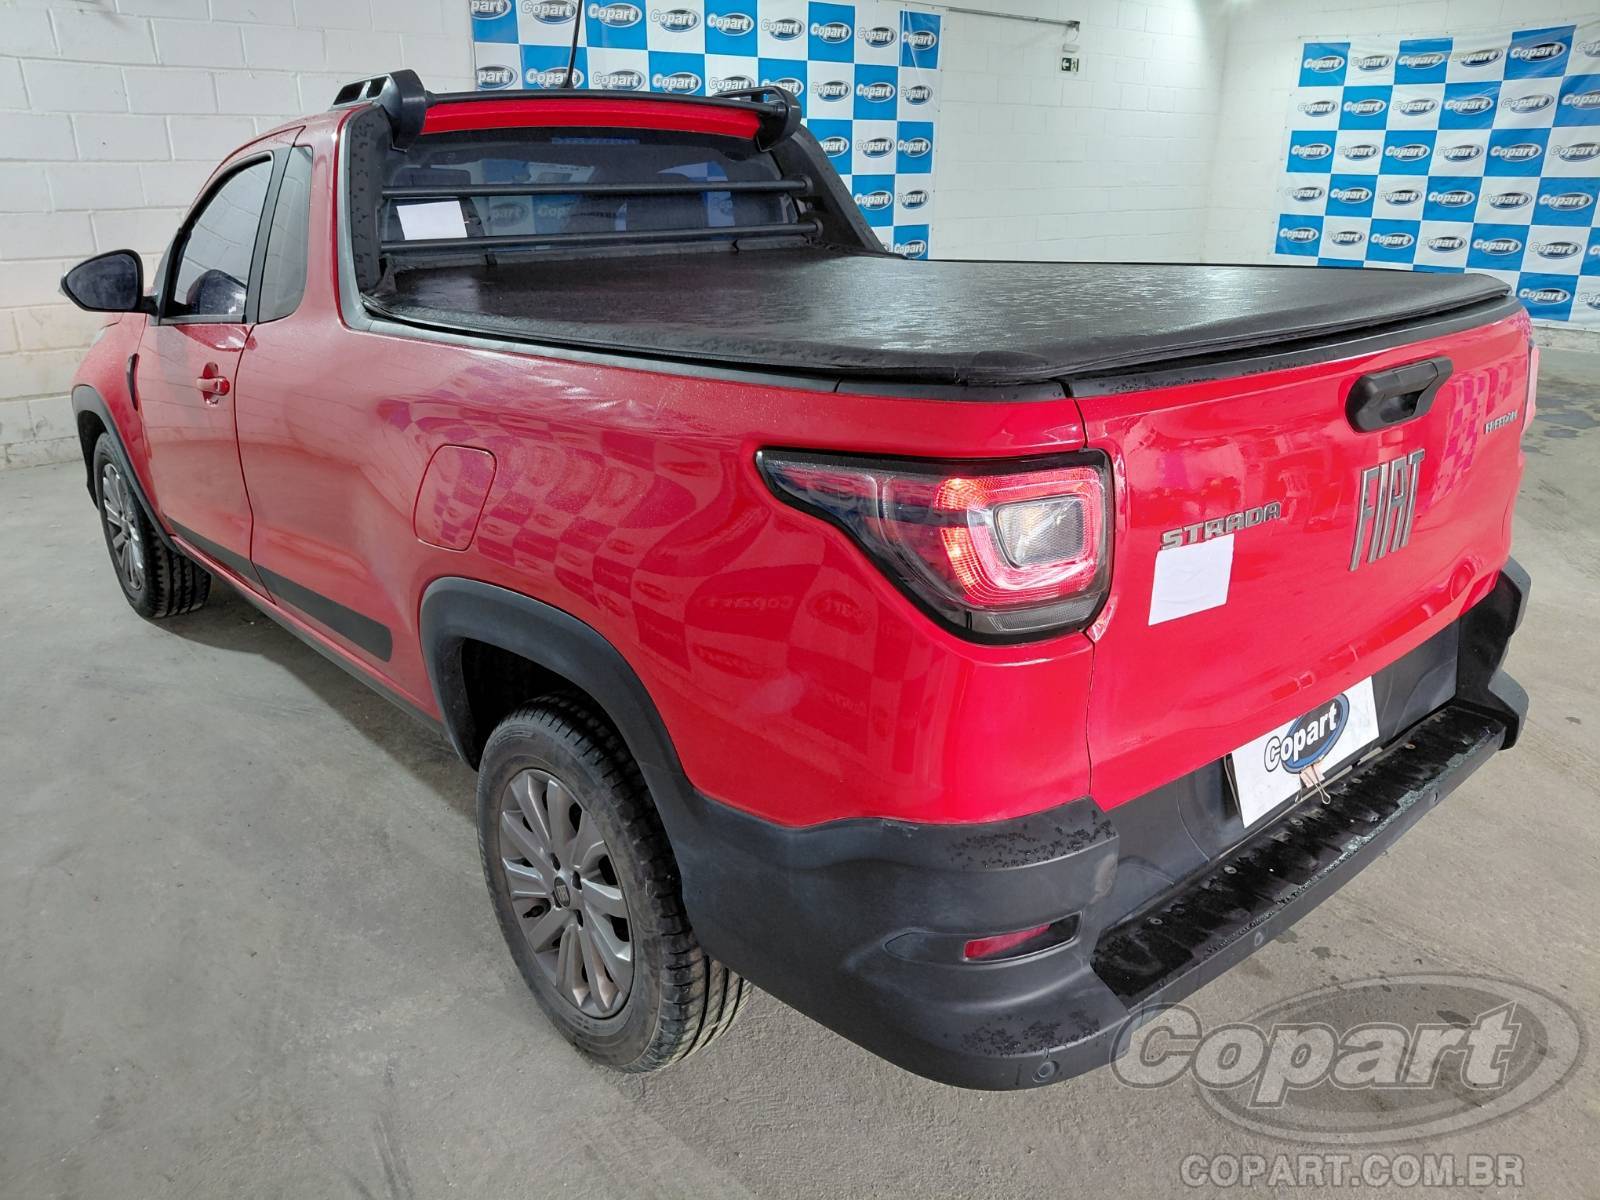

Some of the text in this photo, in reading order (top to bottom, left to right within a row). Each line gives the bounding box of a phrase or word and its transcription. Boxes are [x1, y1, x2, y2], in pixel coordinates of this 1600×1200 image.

[470, 0, 504, 15] part
[521, 0, 573, 19] Copart
[588, 3, 637, 21] Copart
[650, 8, 696, 26] Copart
[707, 13, 750, 31] Copart
[761, 18, 800, 35] Copart
[809, 23, 848, 38] Copart
[857, 28, 892, 43] Copart
[903, 31, 933, 46] Copart
[1509, 43, 1561, 59] Copart
[1303, 55, 1340, 71] Copart
[1351, 54, 1389, 68] Copart
[1397, 53, 1442, 67] Copart
[477, 69, 511, 86] part
[525, 68, 577, 88] Copat
[593, 72, 640, 89] Copart
[652, 73, 697, 91] Copart
[708, 76, 750, 92] Copart
[813, 80, 847, 98] Copart
[856, 84, 892, 99] Copart
[901, 86, 930, 102] Copart
[1298, 101, 1334, 114] Copart
[1343, 100, 1382, 114] Copart
[1392, 100, 1435, 113] Copart
[1444, 98, 1488, 112] Copart
[1500, 96, 1547, 111] Copart
[855, 138, 894, 154] Copart
[897, 139, 927, 154] Copart
[1290, 144, 1328, 157] Copart
[1339, 144, 1376, 158] Copart
[1384, 145, 1425, 158] Copart
[1437, 145, 1477, 159] Copart
[1489, 144, 1538, 158] Copart
[1551, 143, 1599, 158] Copart
[855, 192, 891, 207] Copart
[1329, 188, 1369, 201] Copart
[1379, 190, 1418, 203] Copart
[1428, 191, 1471, 204] Copart
[1485, 193, 1527, 207] Copart
[1538, 193, 1588, 208] Copart
[1279, 227, 1316, 240] Copart
[1370, 232, 1411, 246] Copart
[894, 241, 926, 257] Copart
[1472, 238, 1518, 252] Copart
[1530, 241, 1577, 255] Copart
[1518, 288, 1566, 302] Copart
[1349, 448, 1426, 571] FIAT
[1159, 500, 1283, 551] STRADA
[1264, 702, 1338, 773] Copart
